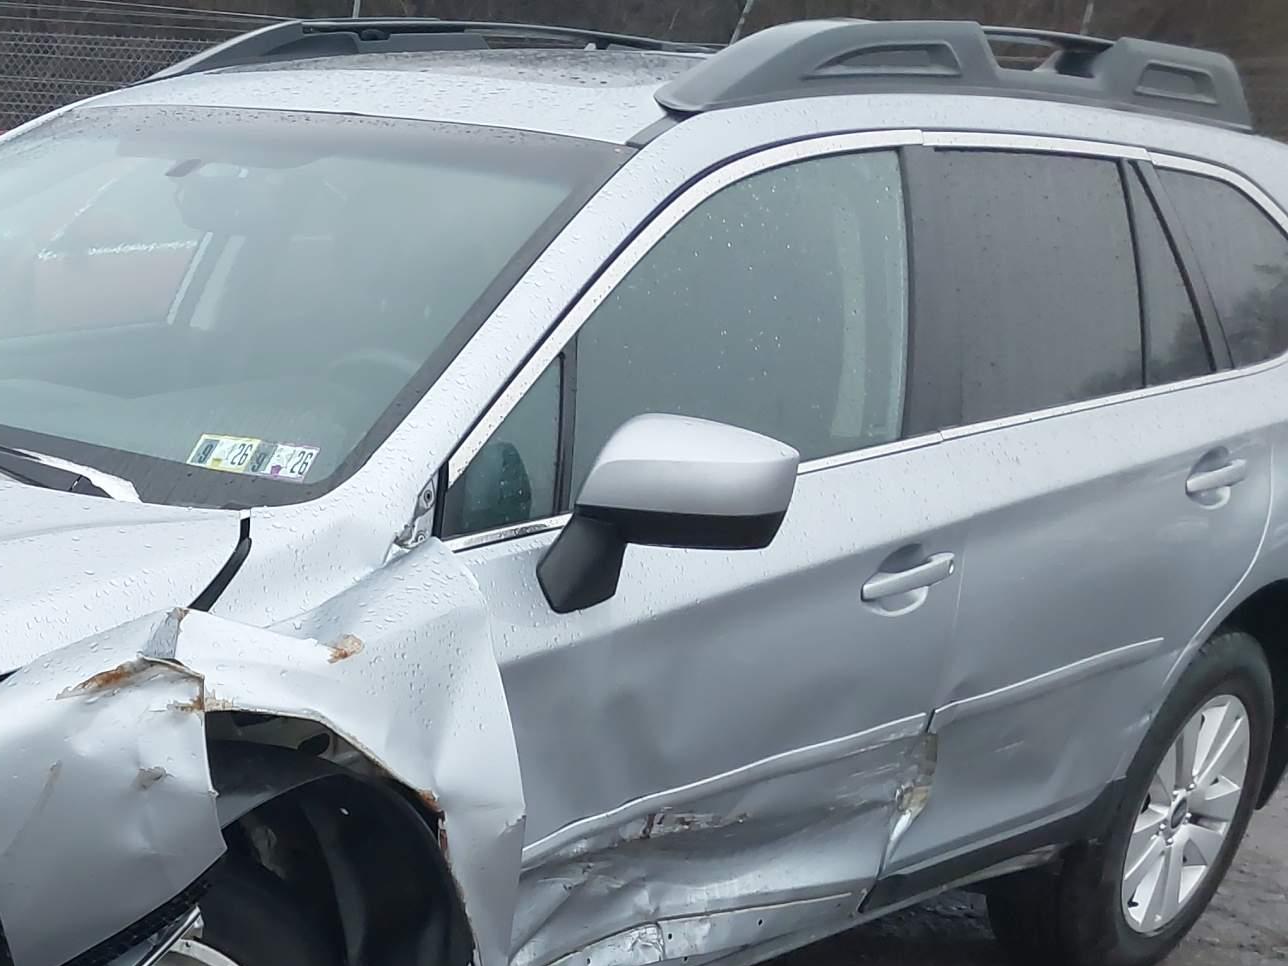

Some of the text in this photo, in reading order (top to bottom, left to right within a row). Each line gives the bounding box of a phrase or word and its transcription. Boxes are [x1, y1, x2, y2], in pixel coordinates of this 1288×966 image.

[199, 443, 253, 466] 9 26
[252, 450, 314, 475] 9 26
